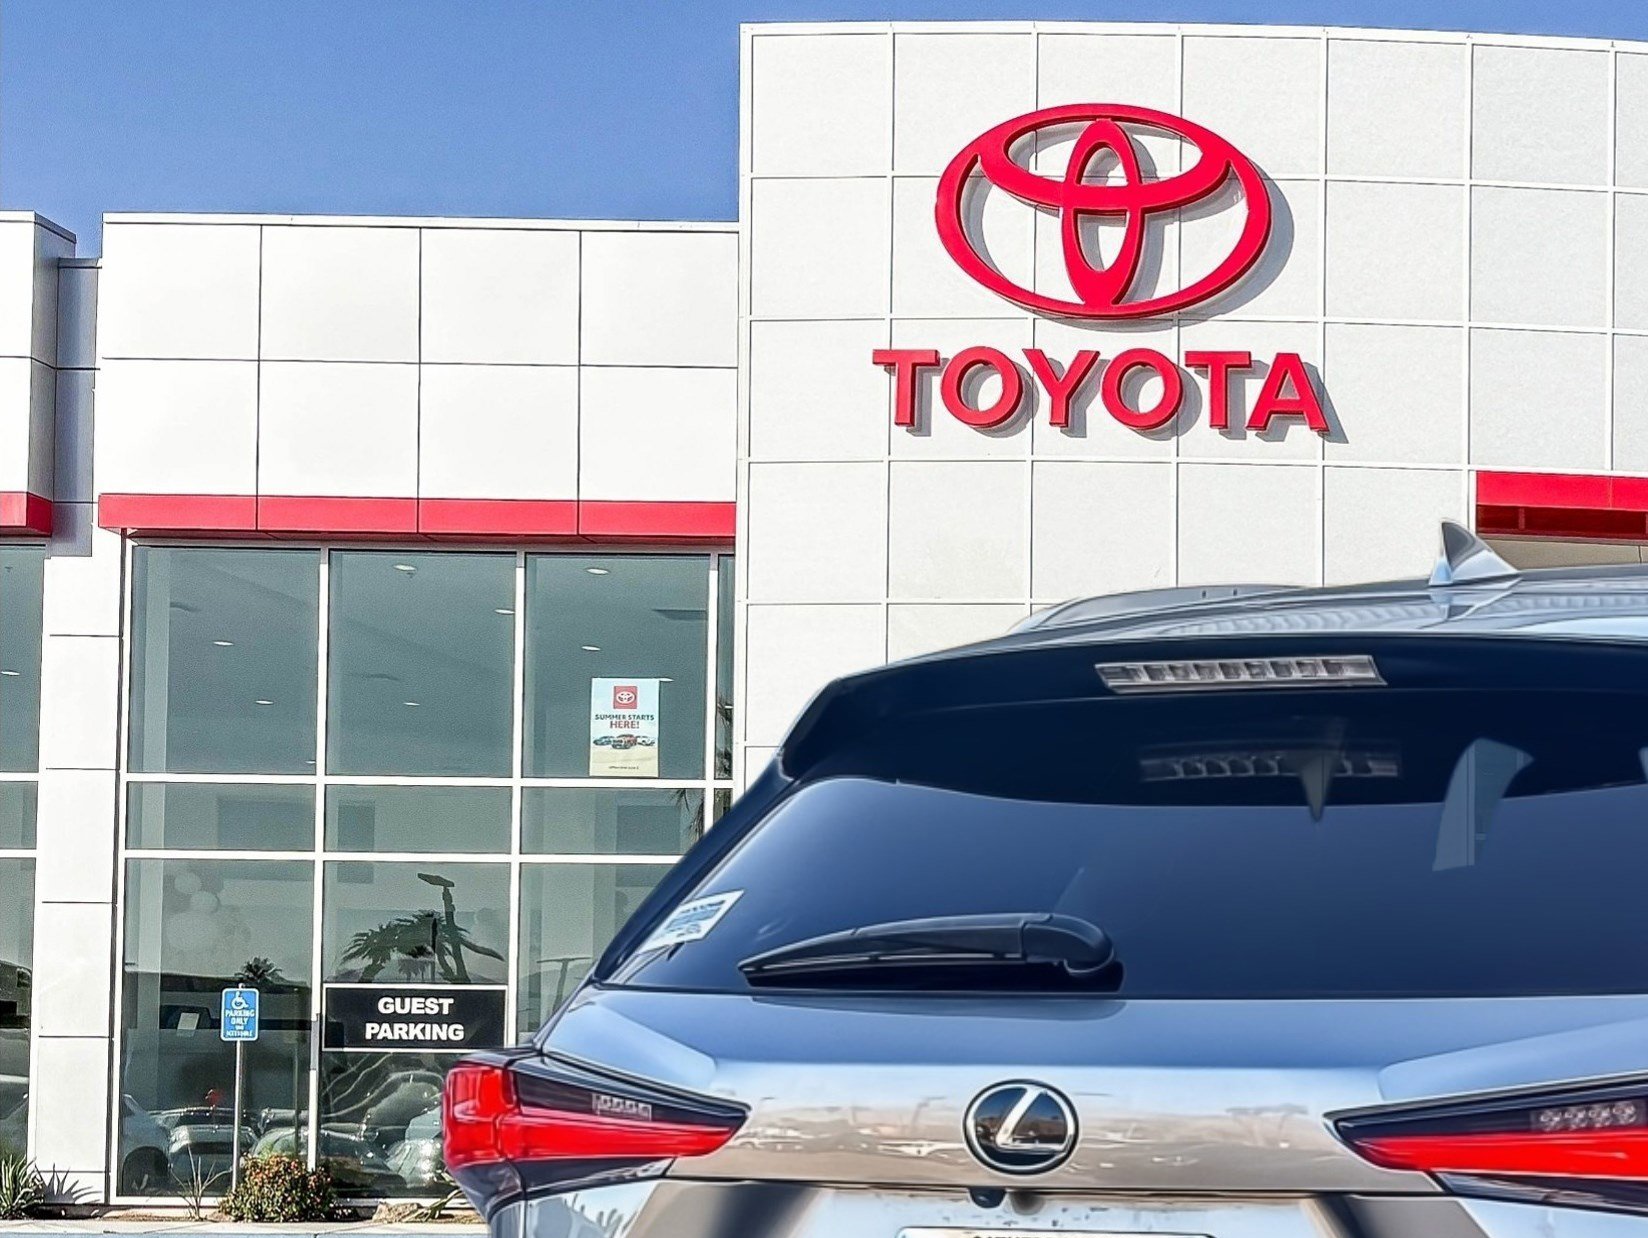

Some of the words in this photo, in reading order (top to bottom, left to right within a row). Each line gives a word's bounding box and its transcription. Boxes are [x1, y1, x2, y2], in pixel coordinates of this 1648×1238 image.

[873, 345, 1330, 433] TOYOTA
[225, 1009, 255, 1017] PARKING
[377, 997, 455, 1015] GUEST
[230, 1017, 249, 1025] ONLY
[364, 1022, 465, 1041] PARKING
